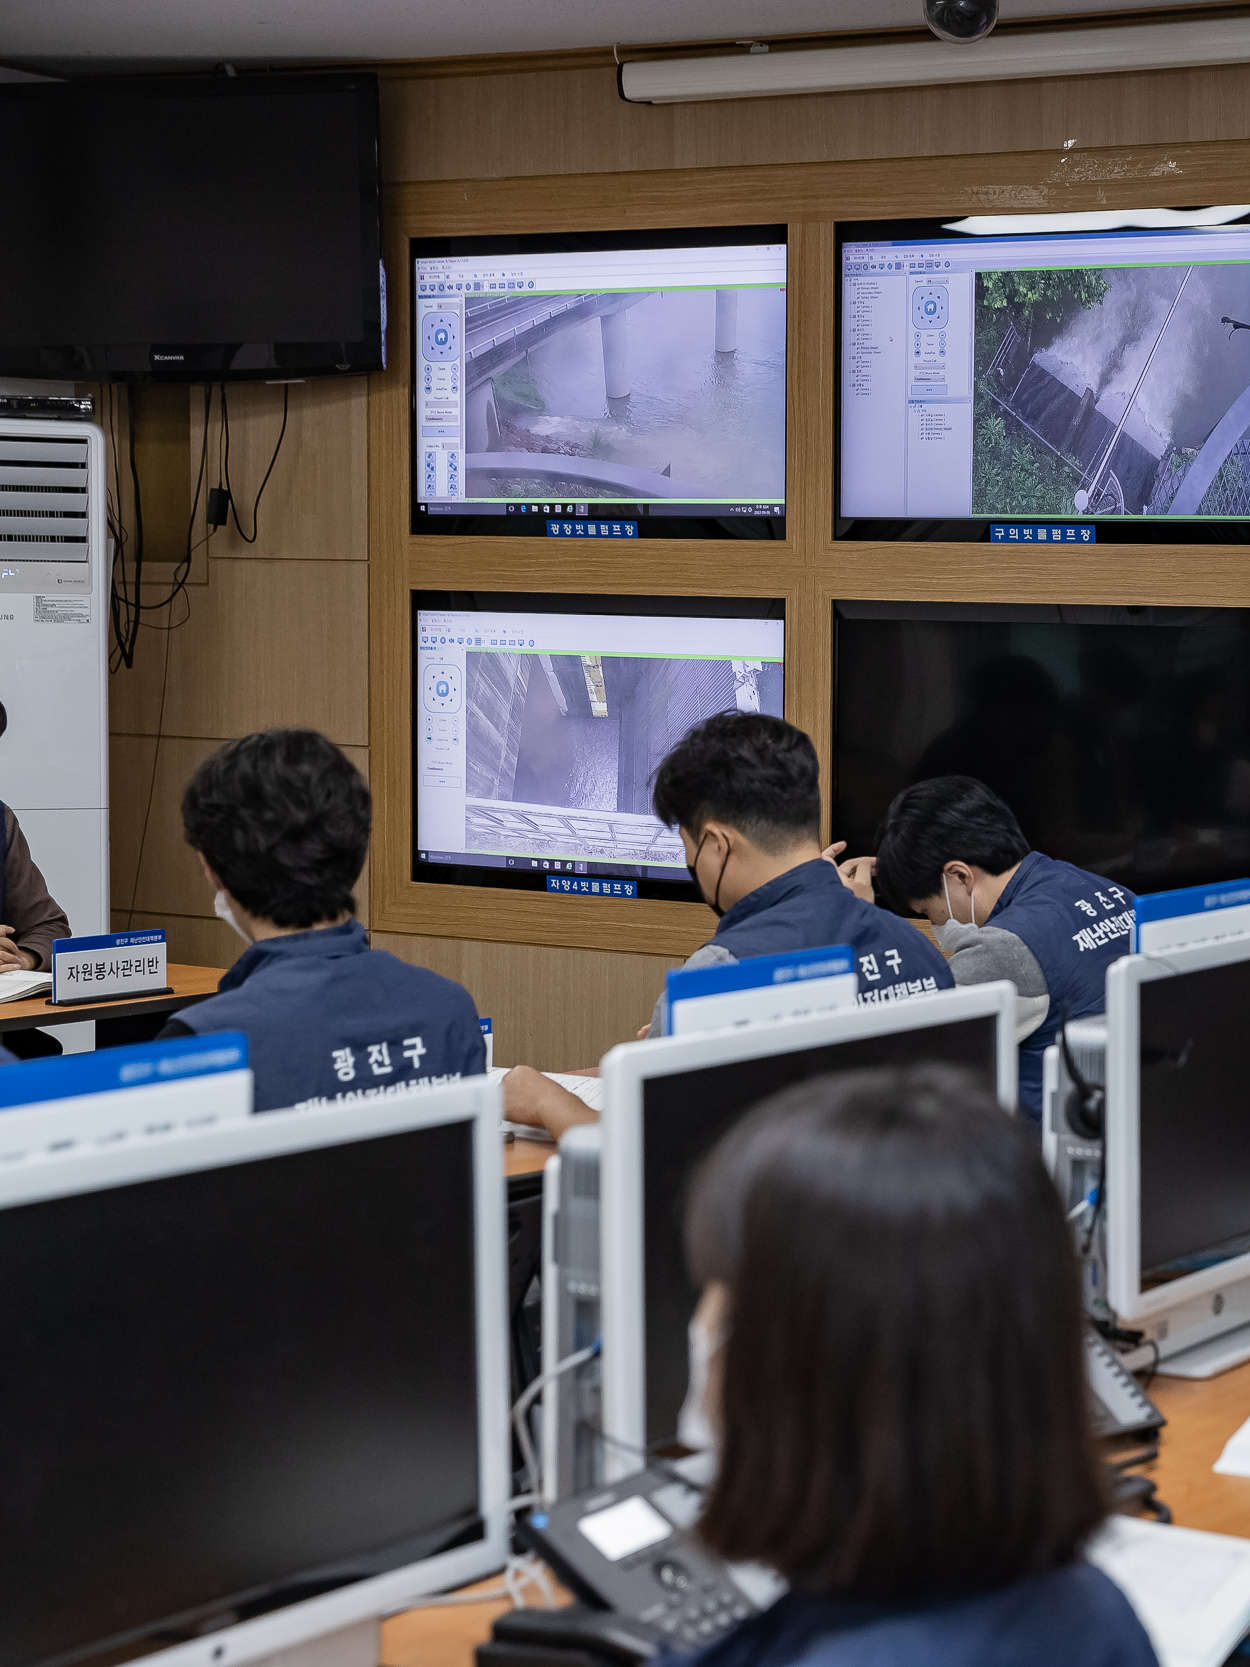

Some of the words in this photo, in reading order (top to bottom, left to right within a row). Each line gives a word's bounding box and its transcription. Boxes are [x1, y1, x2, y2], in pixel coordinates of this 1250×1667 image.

[551, 524, 634, 536] 광장빗물펌프장
[995, 528, 1091, 542] 구의빗물펌프장
[550, 879, 633, 895] 자양4빗물펌프장
[67, 956, 159, 983] 자원봉사관리반
[858, 948, 902, 981] 진구
[331, 1036, 427, 1082] 광진구
